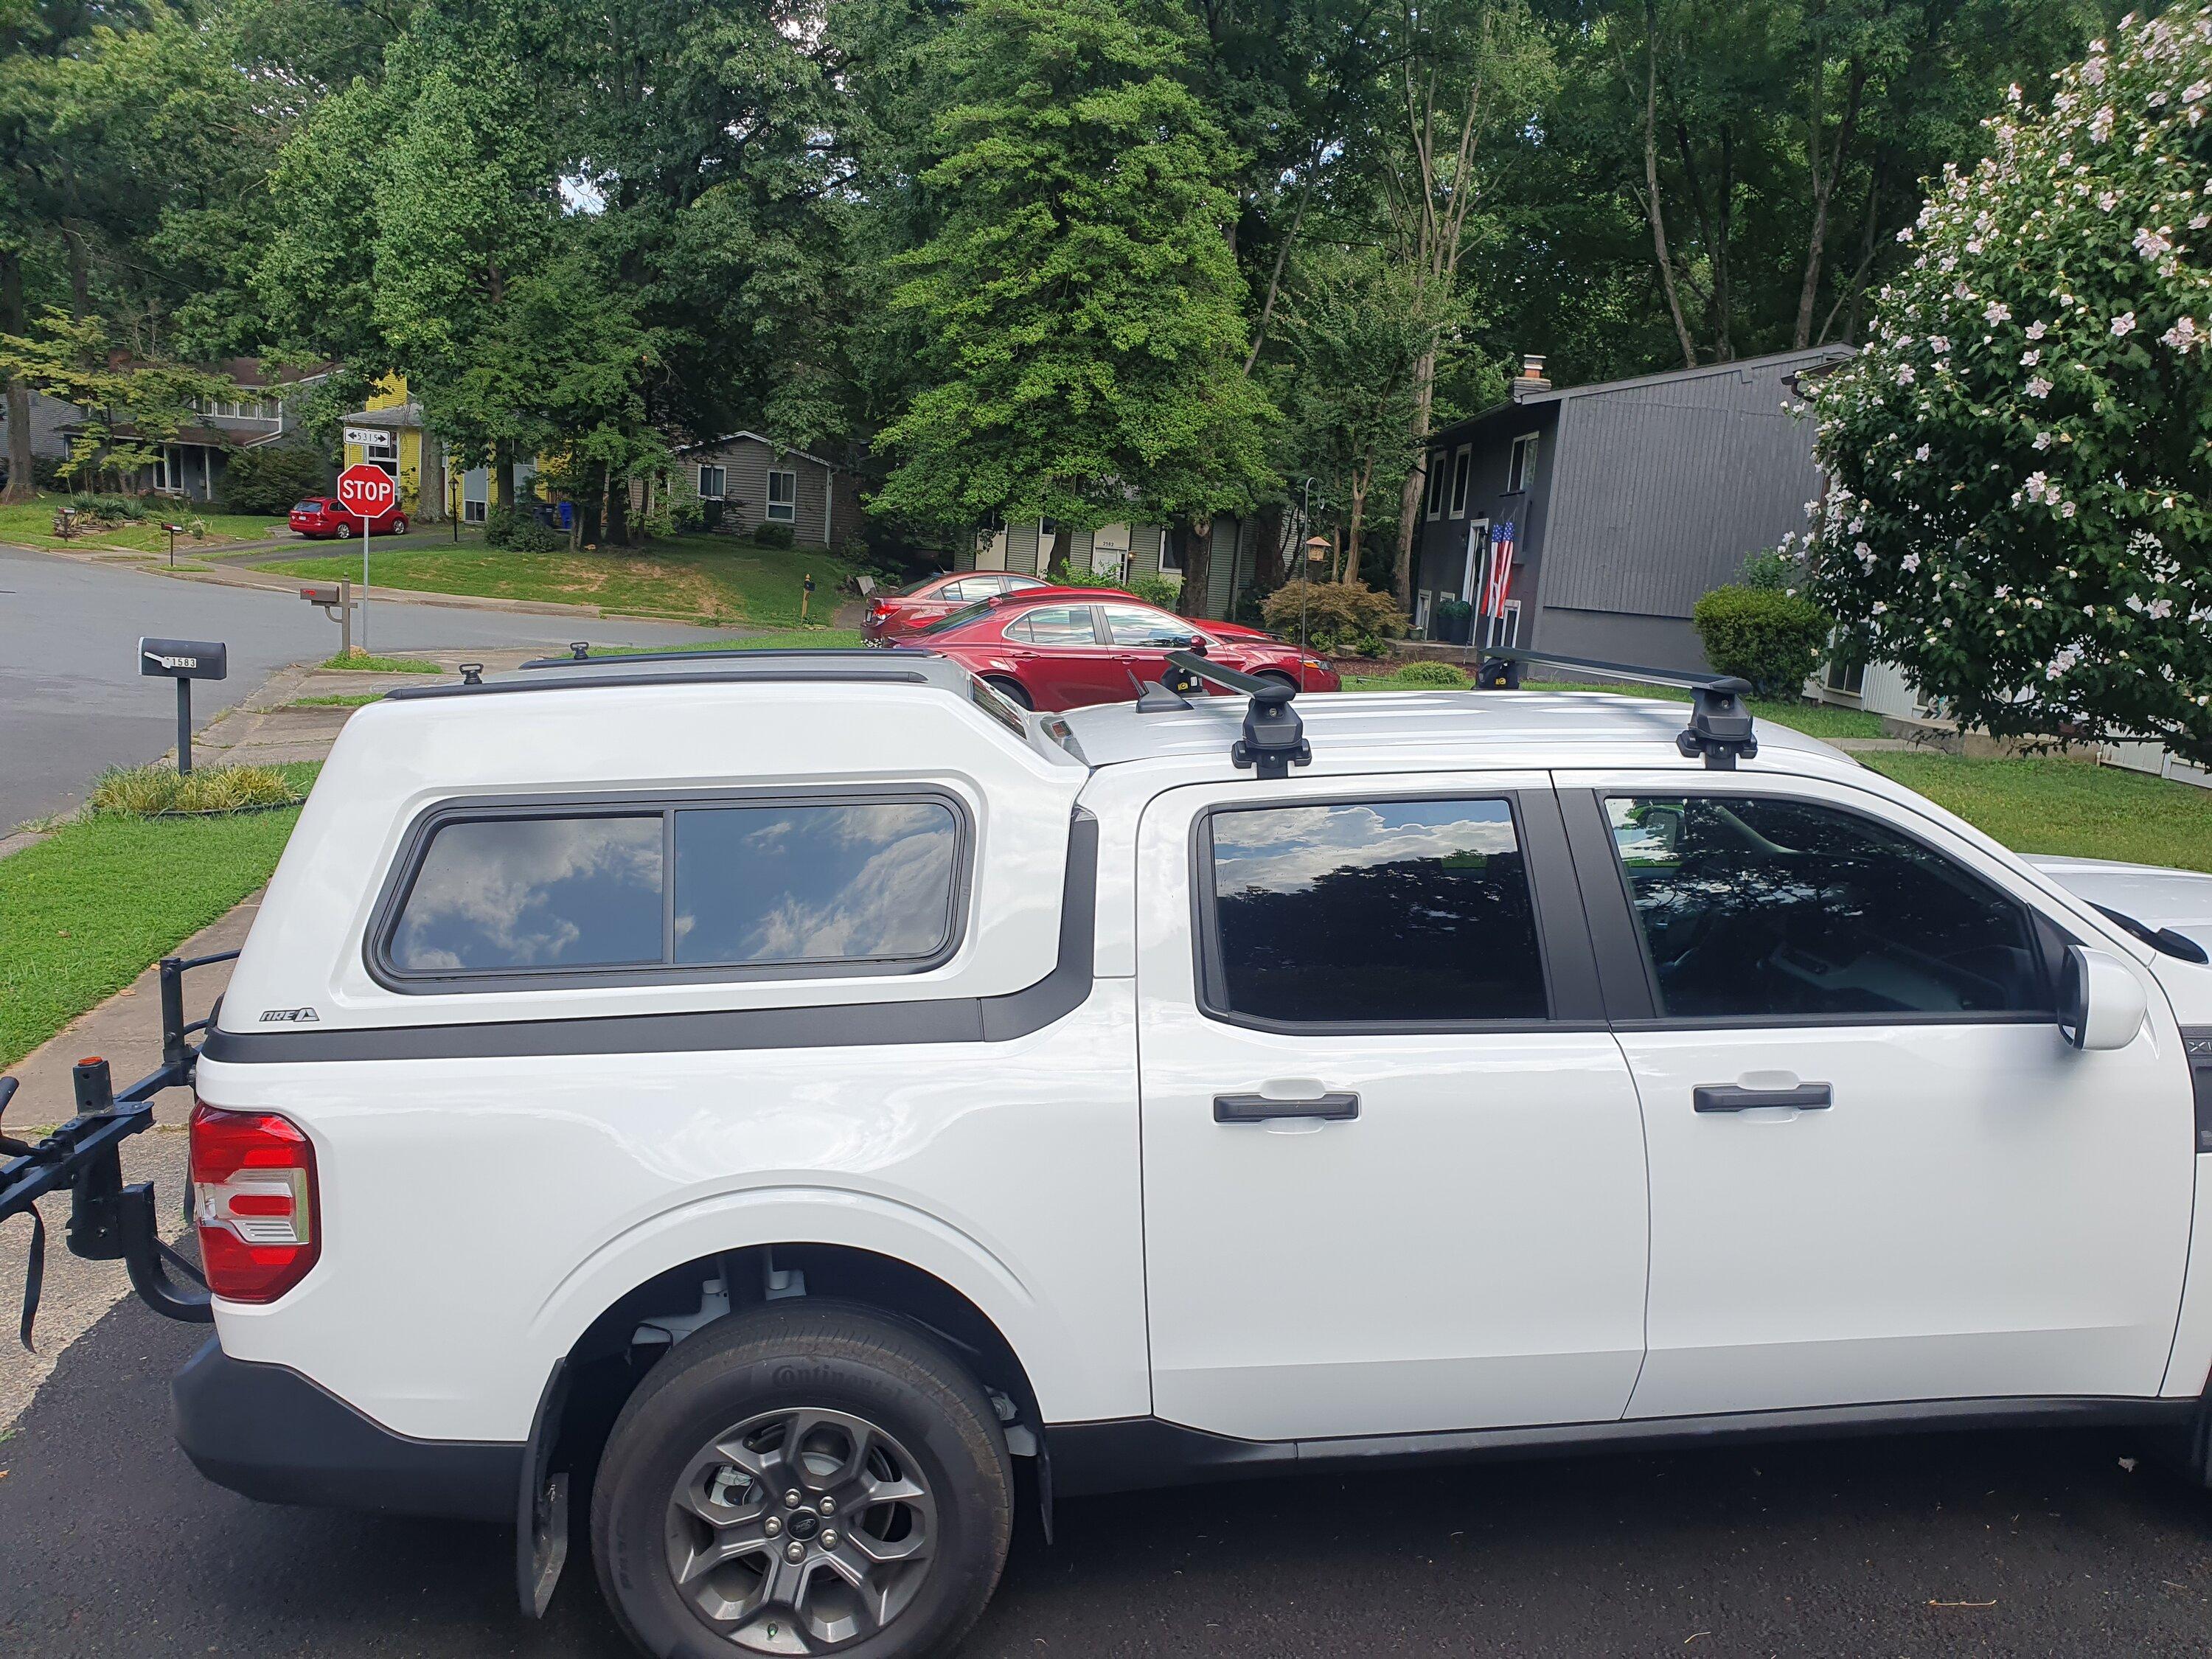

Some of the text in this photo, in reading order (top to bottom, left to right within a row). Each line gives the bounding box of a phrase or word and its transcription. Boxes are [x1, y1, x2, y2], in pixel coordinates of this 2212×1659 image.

[358, 433, 378, 442] 5315
[342, 479, 391, 501] STOP
[166, 658, 195, 667] 1583
